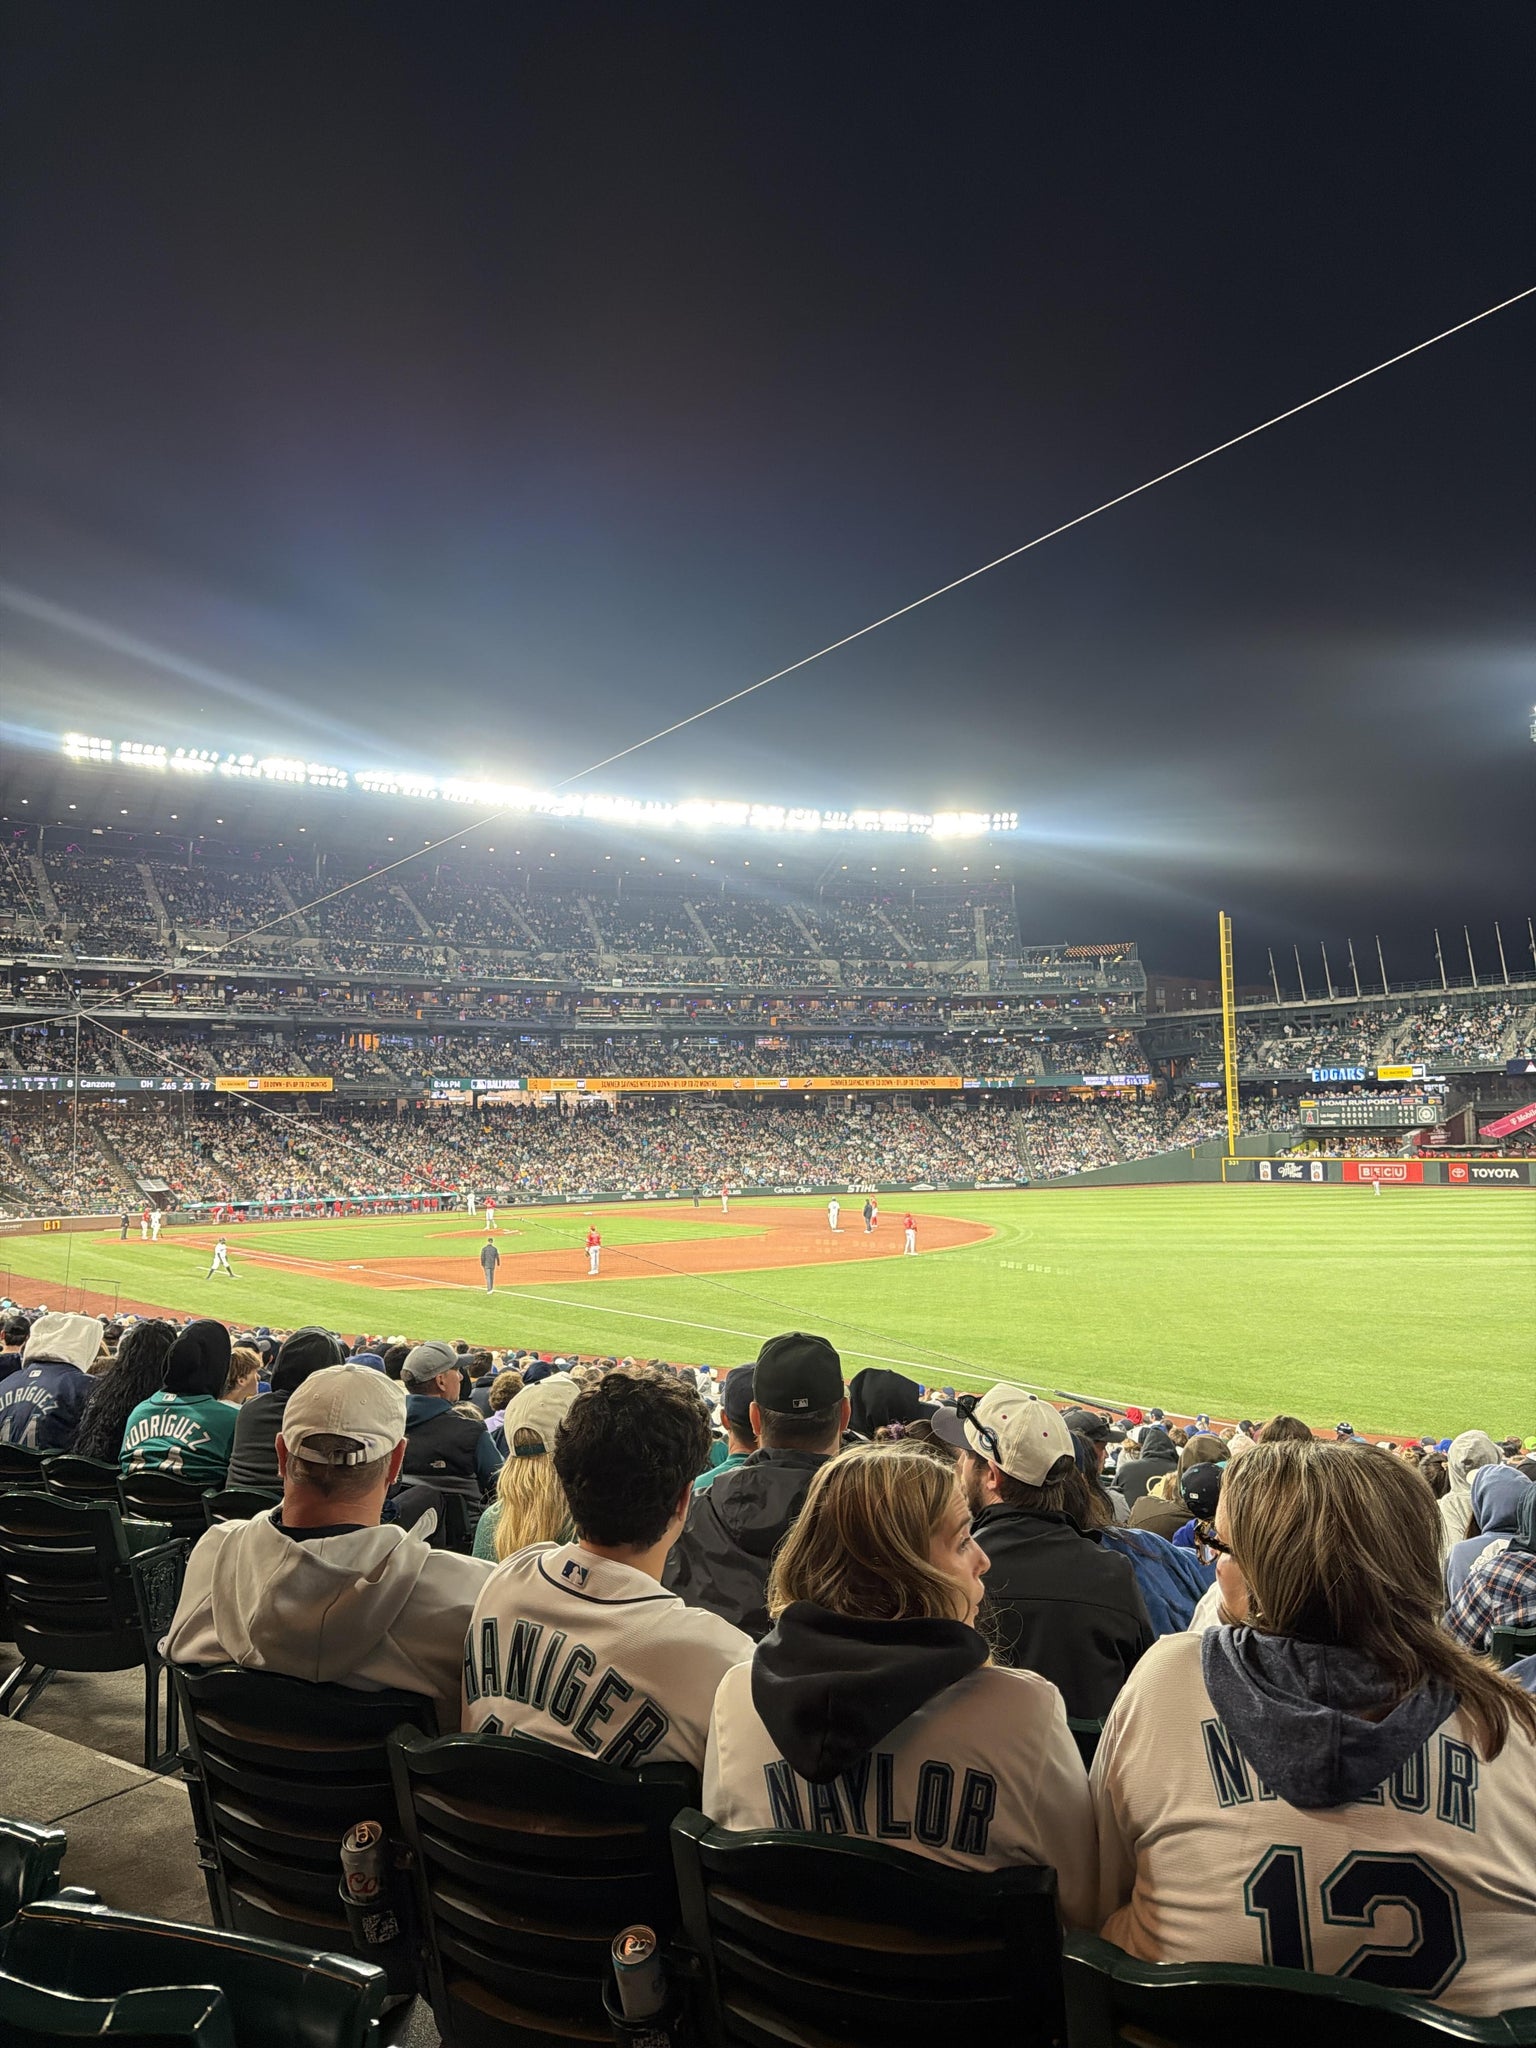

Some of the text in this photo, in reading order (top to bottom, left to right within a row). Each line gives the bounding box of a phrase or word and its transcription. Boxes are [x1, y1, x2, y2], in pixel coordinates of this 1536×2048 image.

[1312, 1067, 1365, 1082] EDGARS
[37, 1082, 44, 1090] 2
[51, 1082, 56, 1090] 1
[66, 1079, 74, 1088] 8
[80, 1079, 116, 1088] Canzone
[140, 1079, 154, 1088] DH
[159, 1082, 211, 1090] .265 23 77
[433, 1080, 461, 1088] 8:46 PM
[487, 1080, 520, 1089] BALLPARK
[1363, 1166, 1403, 1177] BECU
[1472, 1168, 1519, 1179] TOYOTA
[774, 1185, 813, 1194] Great Clips
[846, 1184, 878, 1193] STIHL
[0, 1380, 59, 1415] ODRÍGUEZ
[763, 1751, 997, 1855] NAYLOR
[1243, 1844, 1467, 2000] 12
